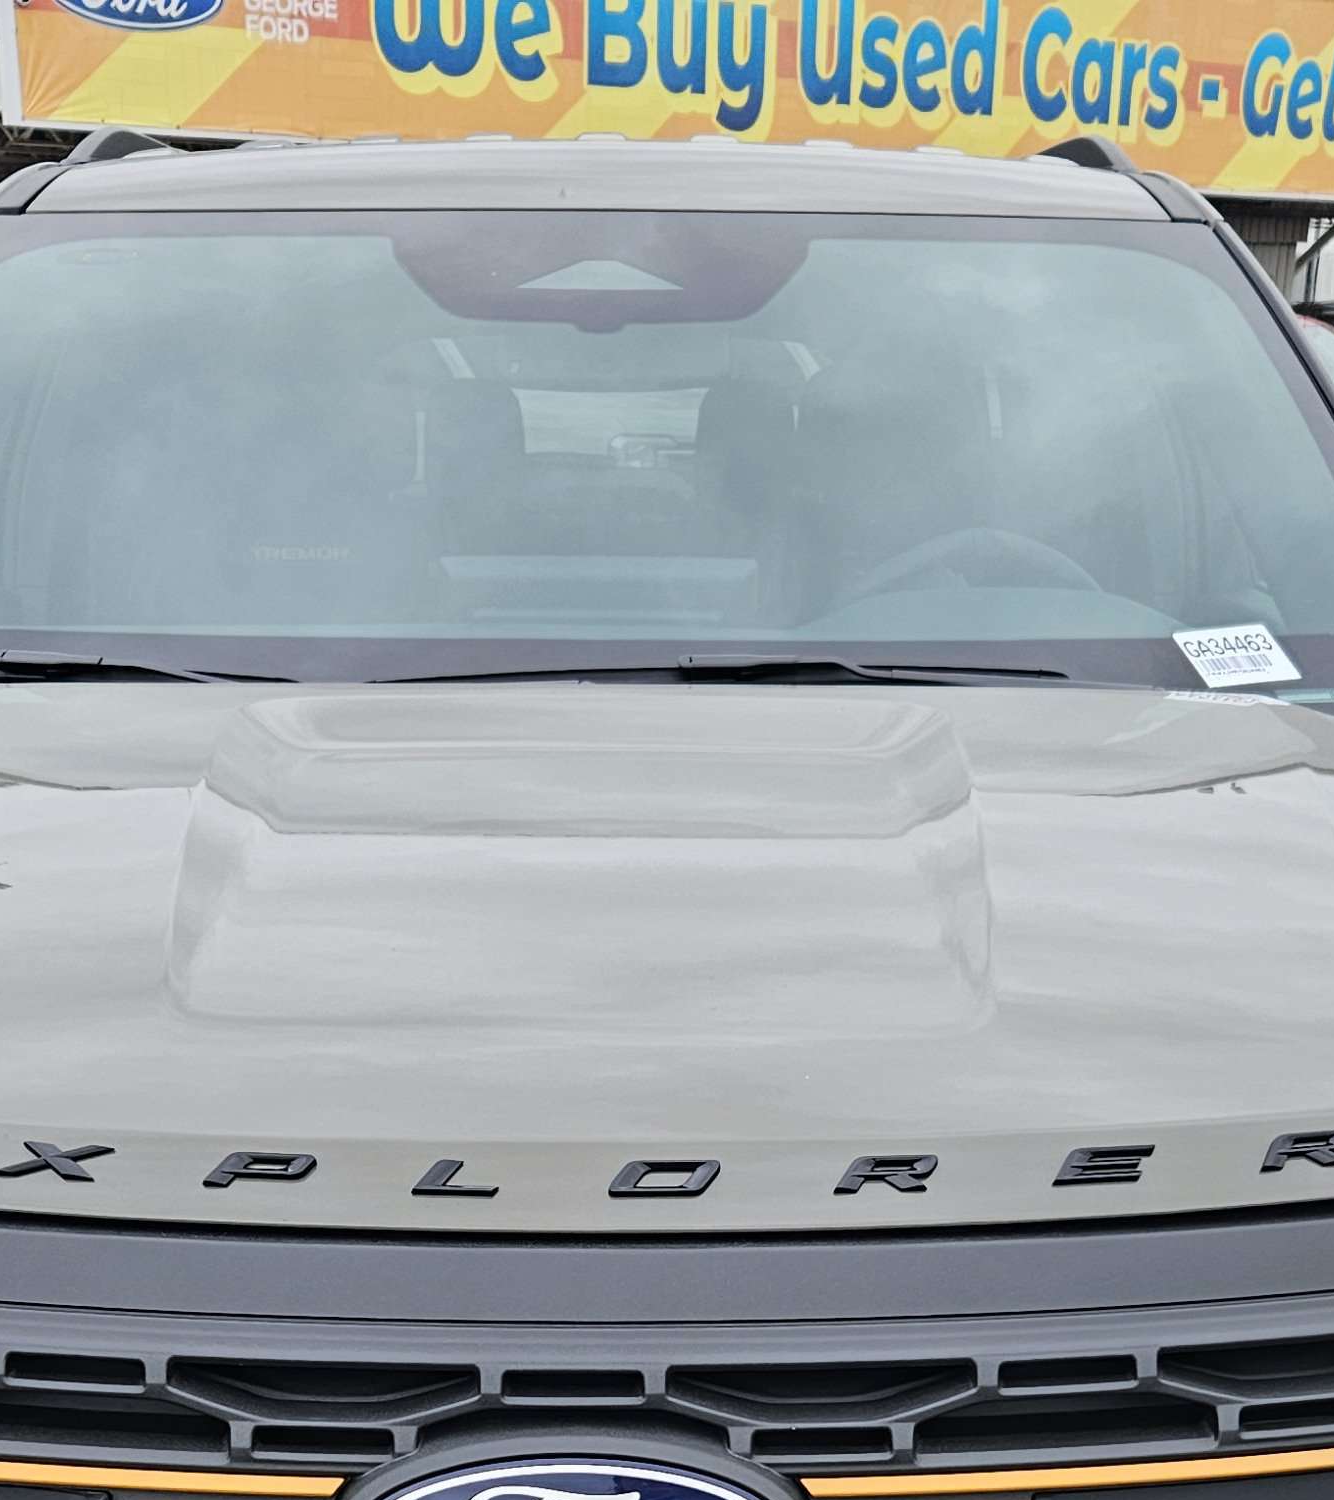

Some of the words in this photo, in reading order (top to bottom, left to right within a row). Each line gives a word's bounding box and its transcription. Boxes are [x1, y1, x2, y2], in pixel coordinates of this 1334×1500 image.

[78, 0, 188, 18] ord
[244, 15, 310, 43] FORD
[373, 0, 551, 82] We
[586, 0, 768, 131] Buy
[800, 0, 998, 116] Used
[1023, 6, 1180, 130] Cars
[1183, 633, 1273, 658] GA34463
